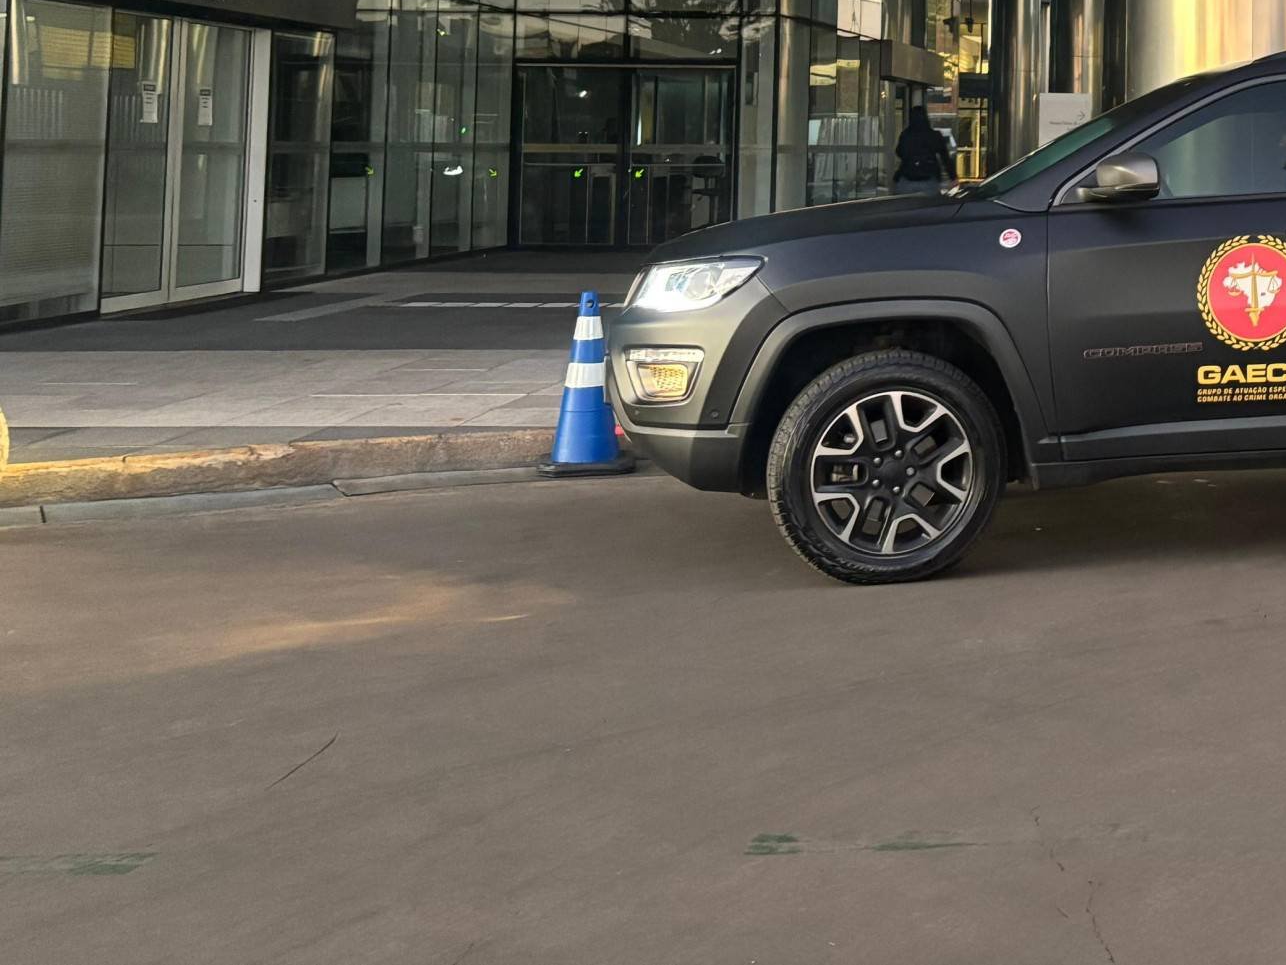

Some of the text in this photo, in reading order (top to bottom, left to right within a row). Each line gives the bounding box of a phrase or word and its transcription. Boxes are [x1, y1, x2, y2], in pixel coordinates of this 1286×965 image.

[1223, 387, 1233, 395] DE
[1197, 395, 1231, 403] COMBATE
[1233, 394, 1243, 402] AO
